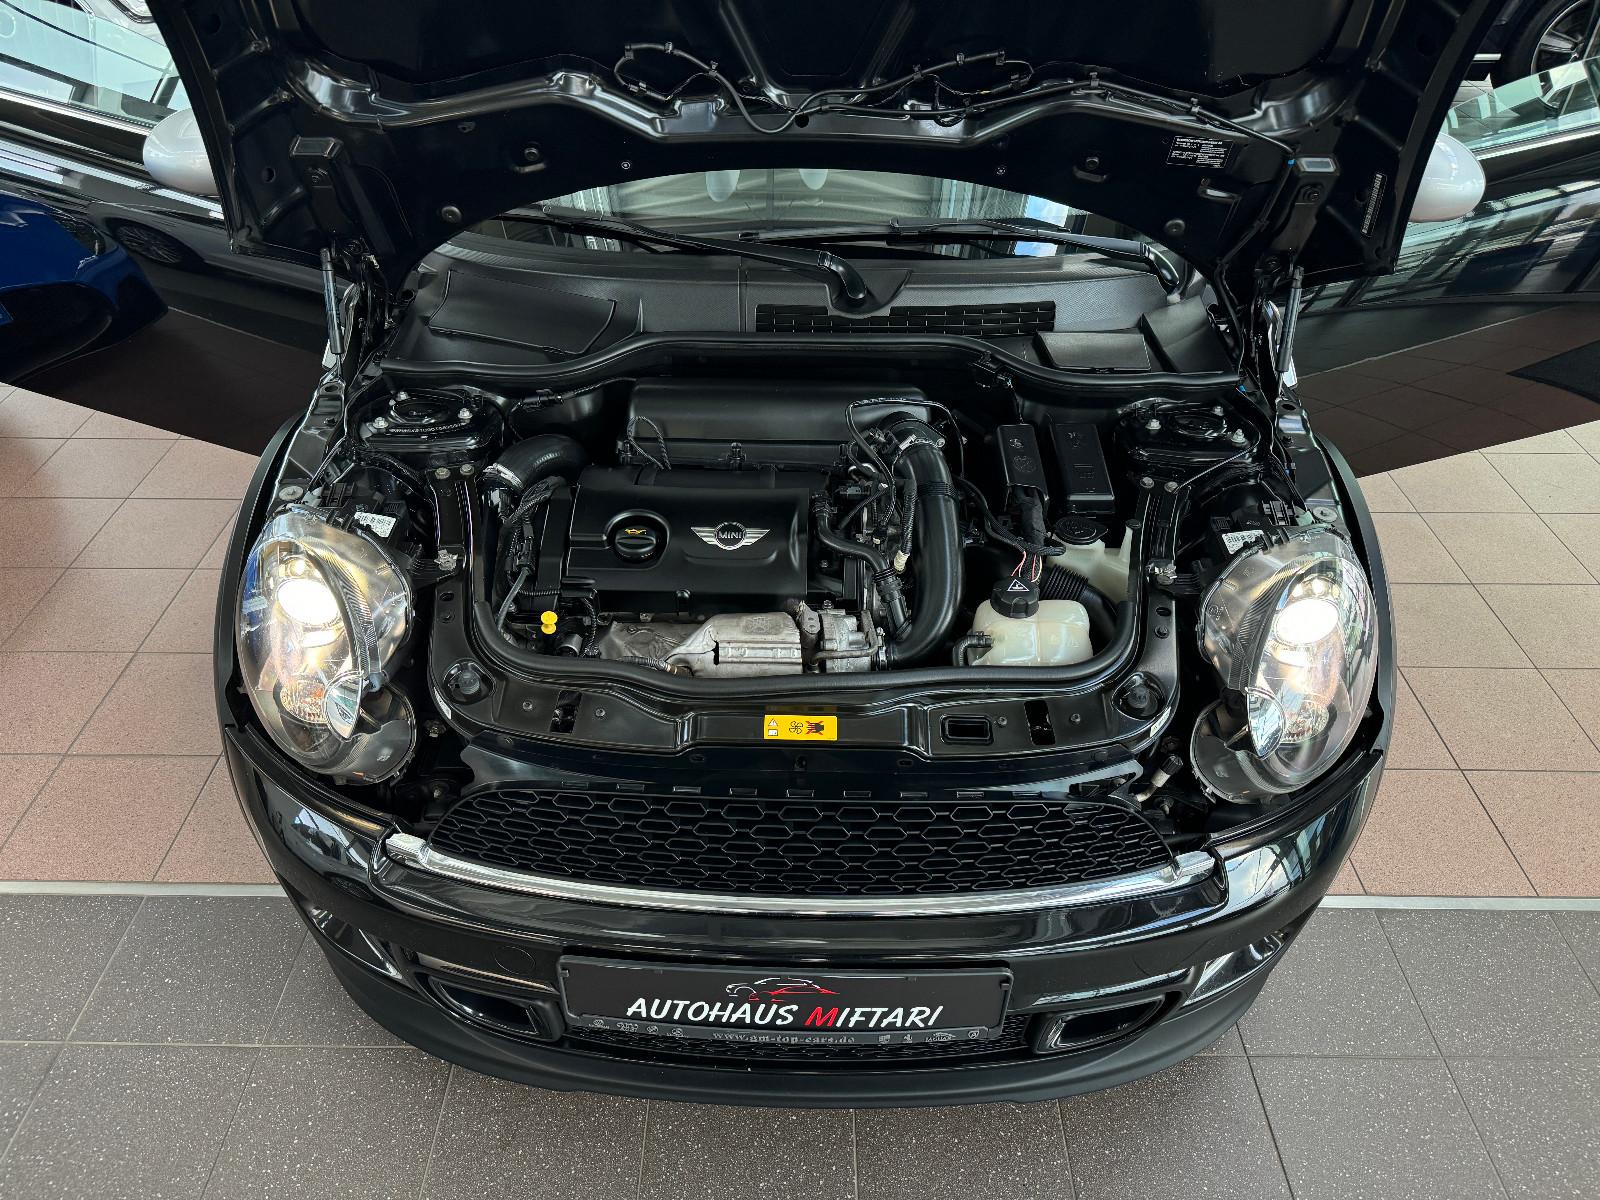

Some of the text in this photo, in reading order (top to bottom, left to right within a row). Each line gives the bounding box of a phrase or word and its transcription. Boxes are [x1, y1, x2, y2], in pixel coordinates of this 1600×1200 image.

[718, 531, 743, 539] MINI
[626, 997, 944, 1028] AUTOHAUS MIFTARI
